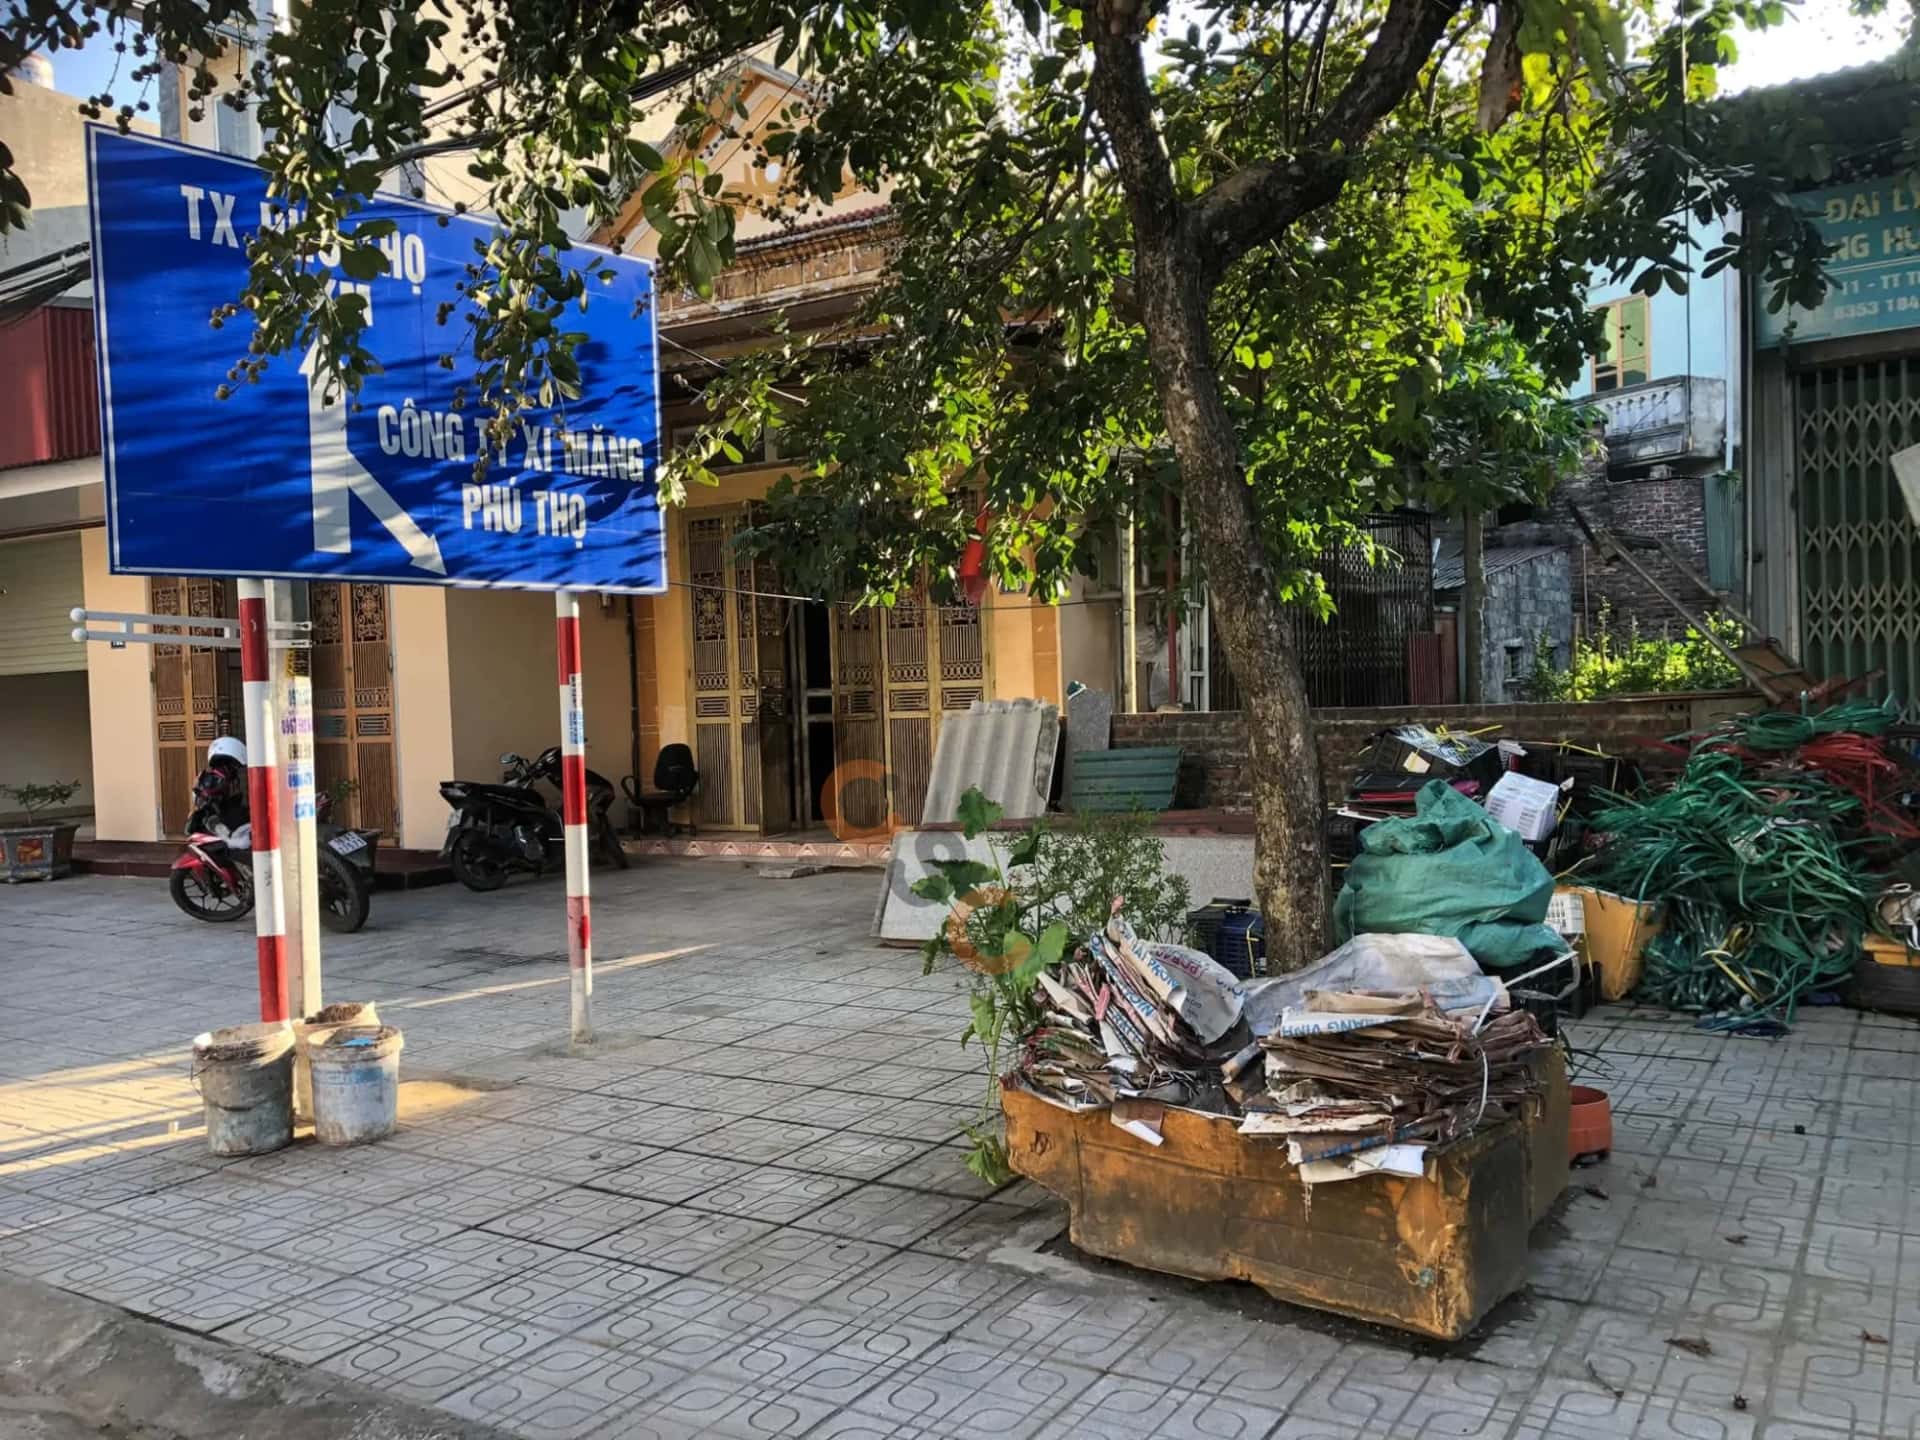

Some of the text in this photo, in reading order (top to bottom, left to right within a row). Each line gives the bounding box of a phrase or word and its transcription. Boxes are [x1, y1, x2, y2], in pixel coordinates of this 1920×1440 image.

[180, 184, 239, 248] TX
[1823, 191, 1881, 225] ĐẠI
[377, 397, 465, 462] CÔNG
[523, 424, 553, 472] XI
[563, 423, 645, 482] MĂNG
[462, 476, 588, 549] PHÚ THỌ
